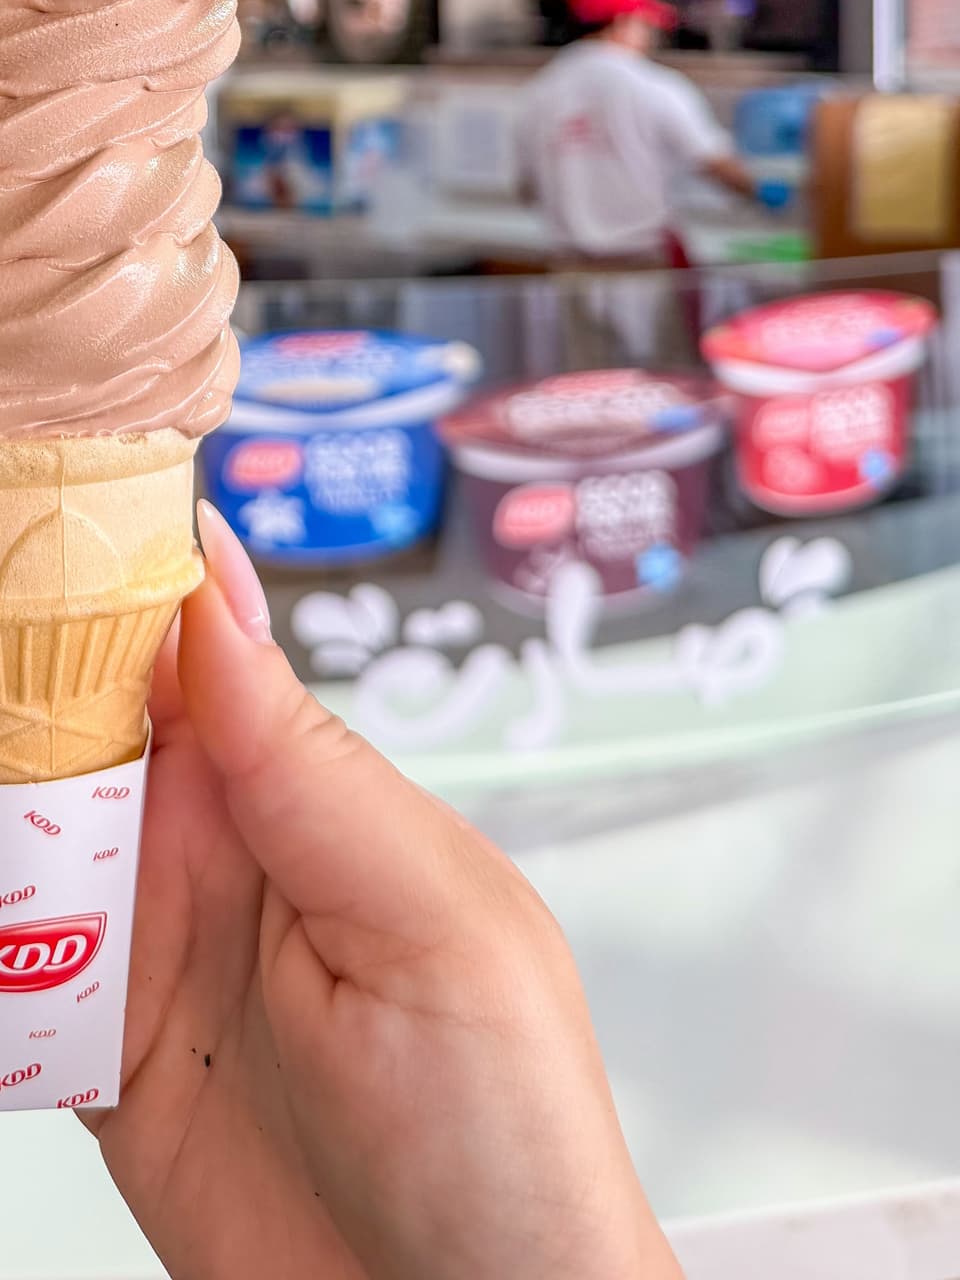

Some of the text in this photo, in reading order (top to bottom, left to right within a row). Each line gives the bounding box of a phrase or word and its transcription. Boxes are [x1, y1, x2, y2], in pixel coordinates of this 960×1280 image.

[92, 786, 131, 800] KDD
[23, 810, 62, 836] KDD
[93, 846, 120, 862] KDD
[76, 981, 101, 1004] KDD
[56, 1088, 100, 1109] KDD
